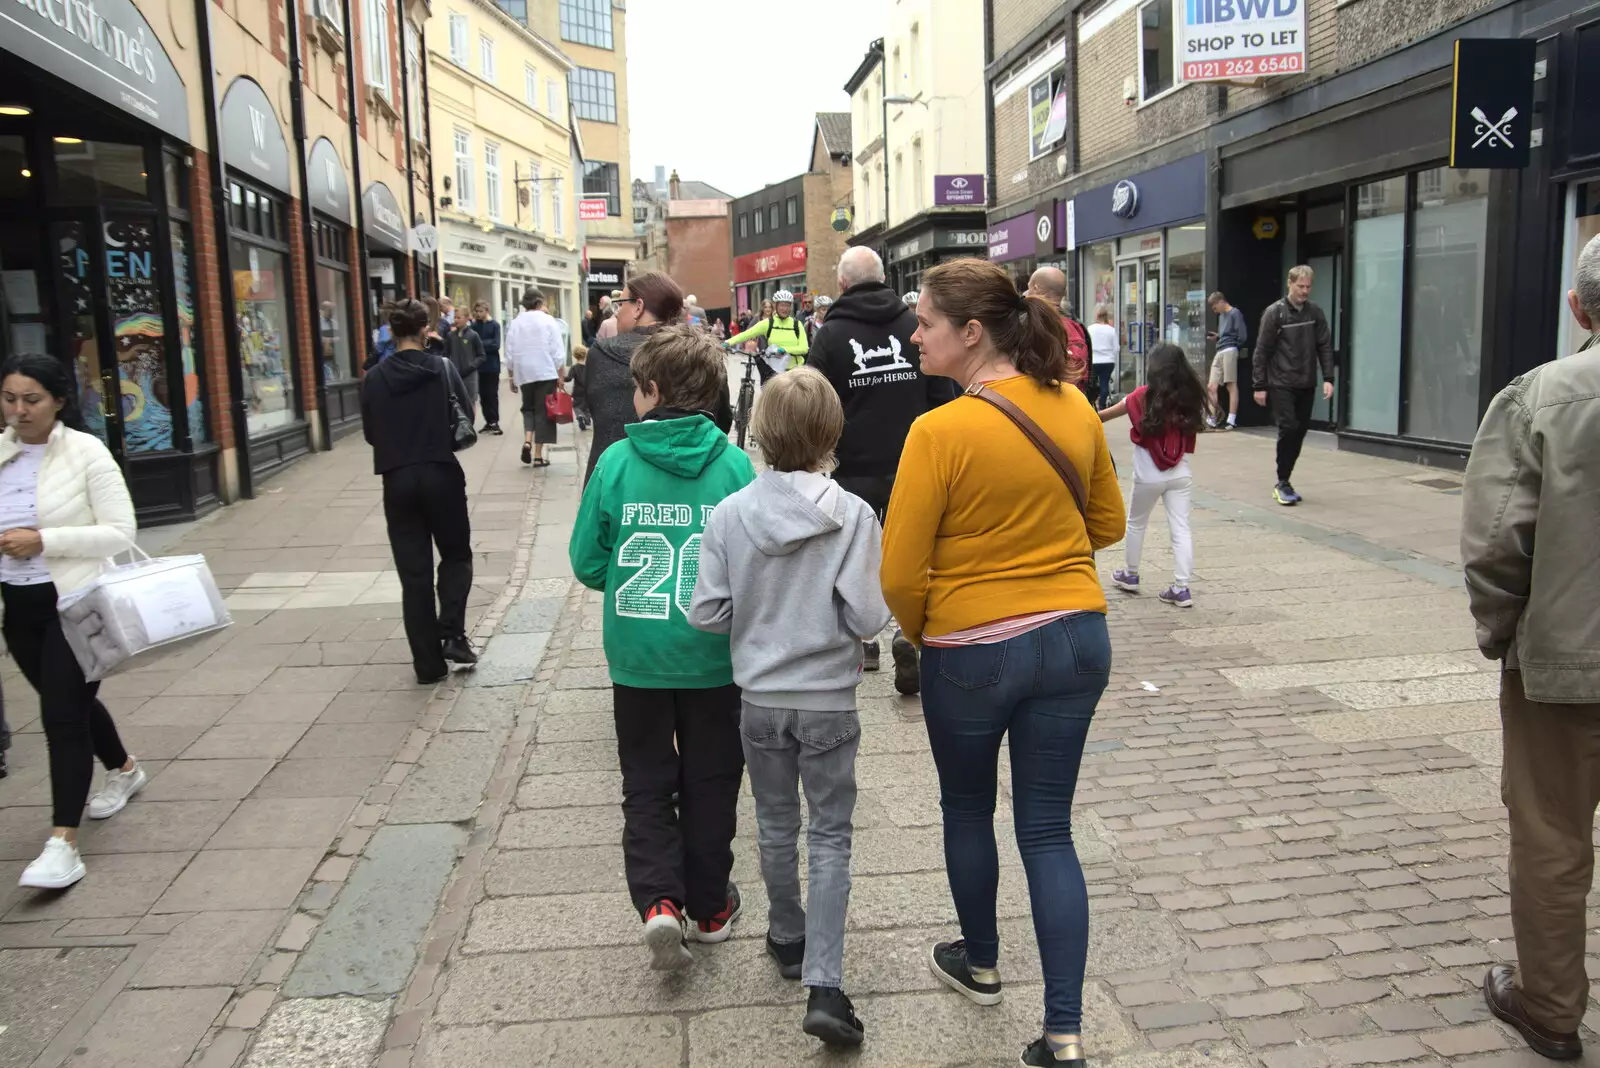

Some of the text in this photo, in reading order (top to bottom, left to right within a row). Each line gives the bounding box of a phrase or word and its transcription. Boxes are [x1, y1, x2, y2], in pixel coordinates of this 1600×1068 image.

[1214, 0, 1298, 22] BWD
[1187, 30, 1297, 53] SHOP TO LET
[1187, 55, 1298, 78] 0121 262 6540
[248, 104, 265, 150] W
[1474, 124, 1512, 135] C C
[1488, 136, 1498, 148] C
[848, 371, 918, 388] HELP for HEROES
[621, 502, 693, 527] FRED
